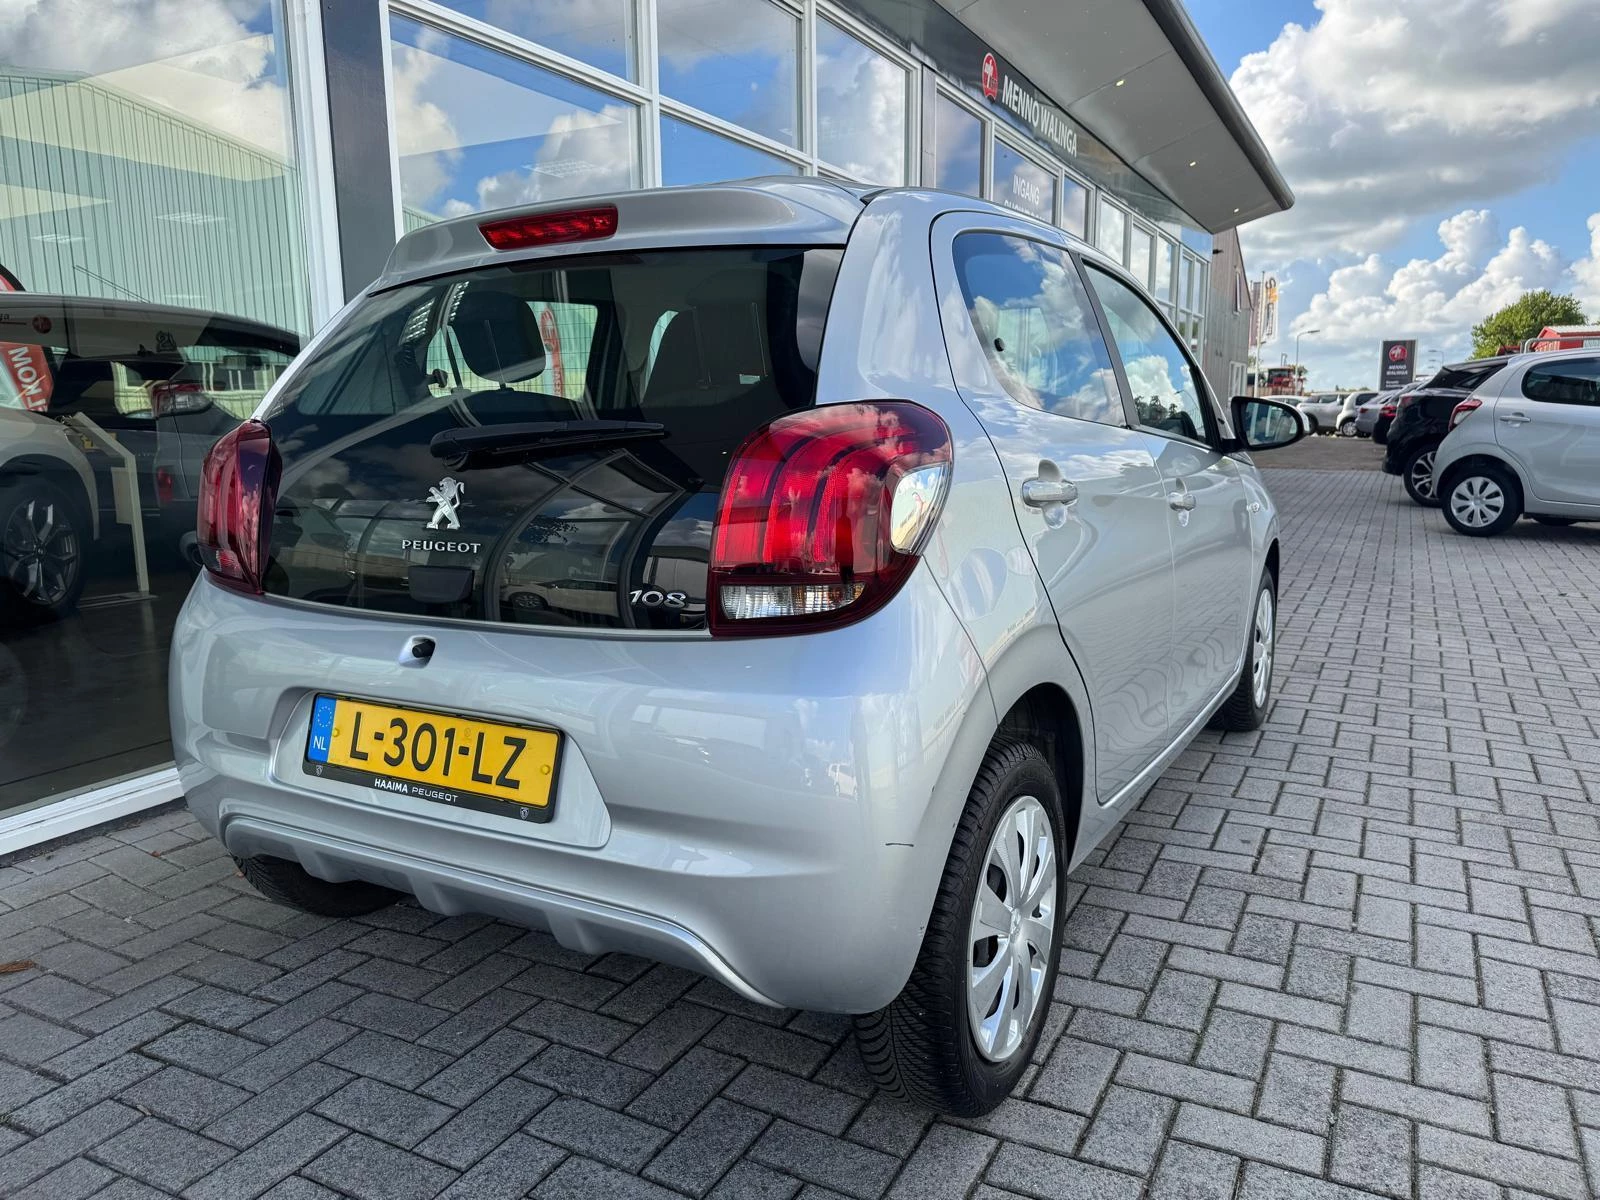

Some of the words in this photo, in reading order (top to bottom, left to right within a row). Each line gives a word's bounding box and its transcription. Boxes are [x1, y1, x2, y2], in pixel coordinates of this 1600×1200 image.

[1002, 75, 1040, 128] MENNO
[1040, 106, 1077, 157] WALINGA
[1013, 174, 1040, 205] INGANG
[401, 539, 481, 554] PEUGEOT
[629, 589, 688, 609] 108
[312, 735, 327, 751] NL
[349, 711, 528, 790] L-301-LZ
[374, 777, 409, 795] HAAIMA
[411, 786, 459, 803] PEUGEOT
